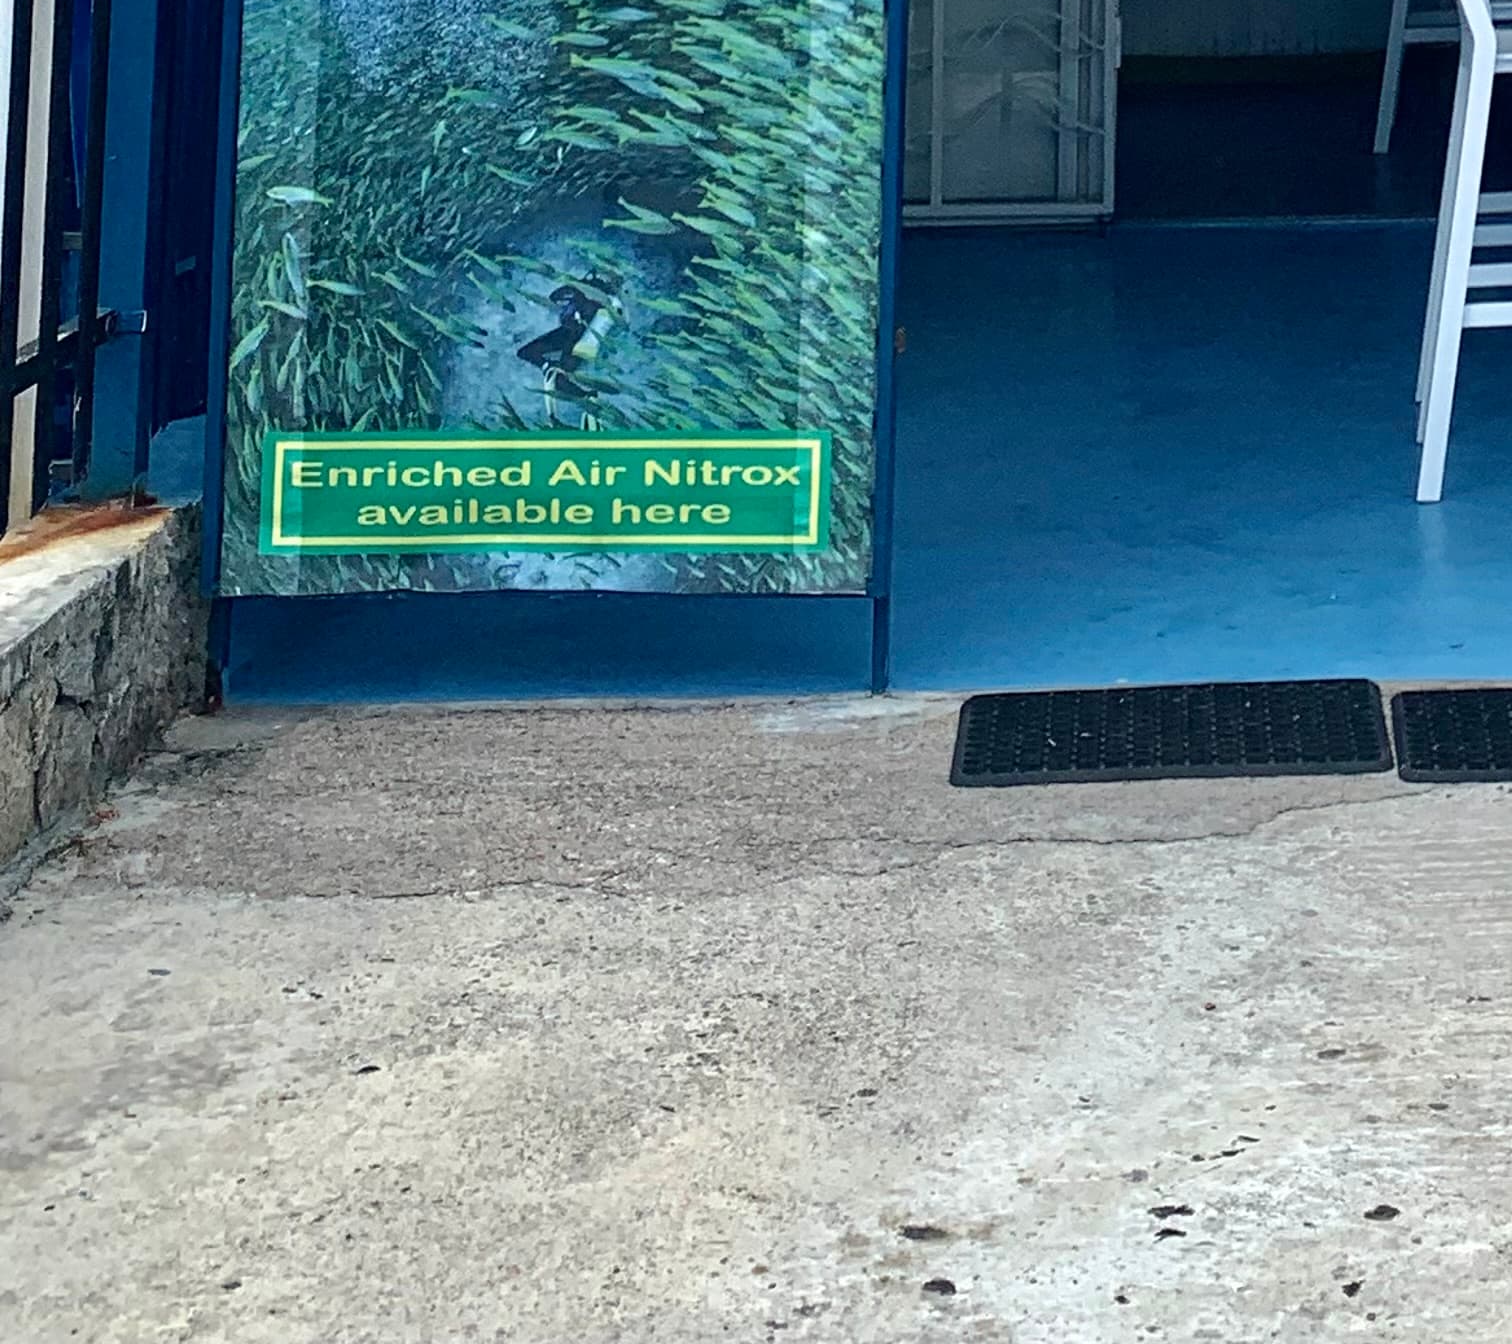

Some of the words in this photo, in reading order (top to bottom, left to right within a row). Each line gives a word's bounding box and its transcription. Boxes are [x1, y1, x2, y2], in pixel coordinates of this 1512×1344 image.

[290, 459, 532, 488] Enriched
[548, 458, 627, 487] Air
[644, 458, 802, 488] Nitrox
[357, 497, 594, 526] available
[611, 497, 732, 525] here
